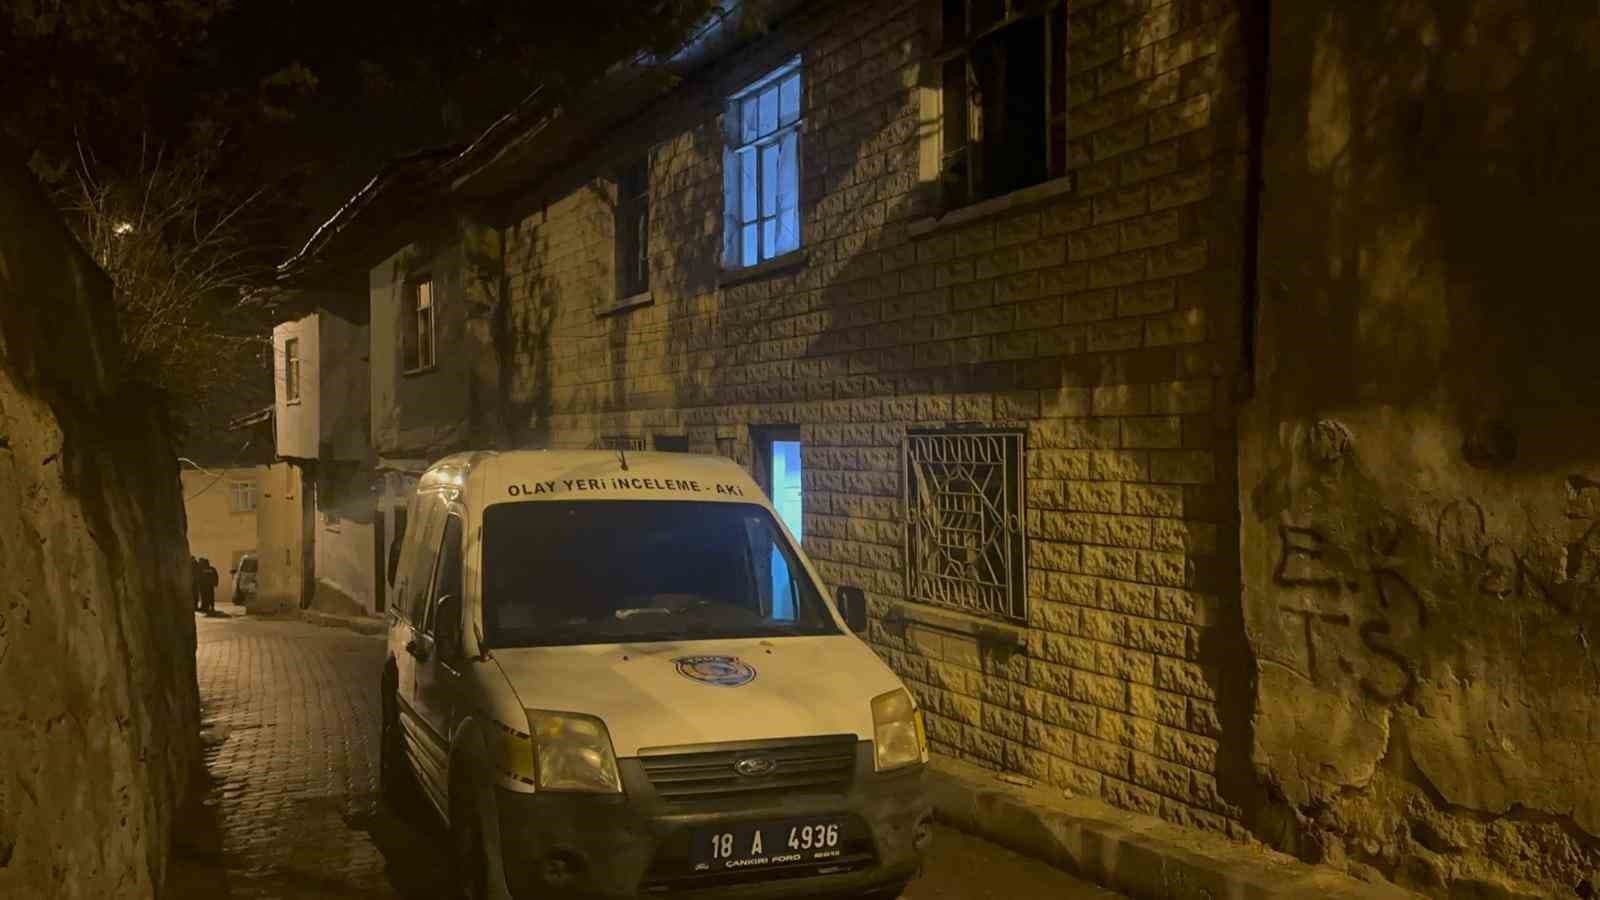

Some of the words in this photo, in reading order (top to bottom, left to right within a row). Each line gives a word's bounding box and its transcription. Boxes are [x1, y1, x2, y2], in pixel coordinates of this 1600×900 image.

[507, 479, 556, 497] OLAY
[711, 834, 734, 859] 18
[751, 830, 763, 855] A
[787, 824, 839, 850] 4936
[771, 853, 801, 863] FORD
